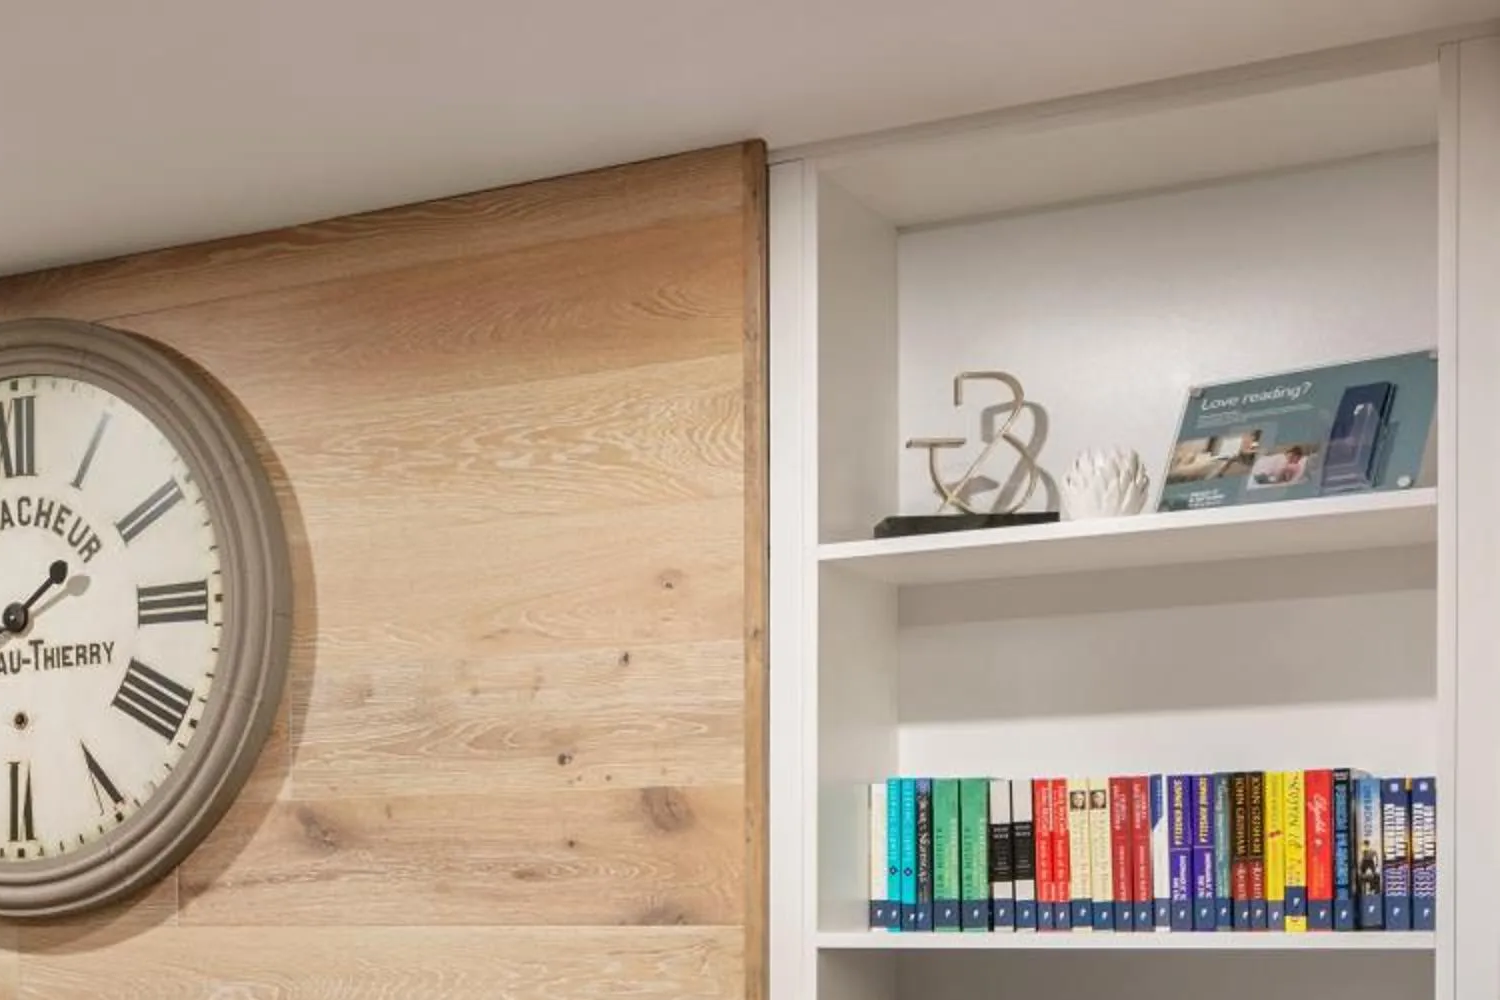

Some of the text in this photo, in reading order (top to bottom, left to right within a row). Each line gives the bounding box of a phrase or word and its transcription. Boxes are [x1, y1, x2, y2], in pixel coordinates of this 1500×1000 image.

[1200, 381, 1313, 412] Love reading?
[115, 477, 185, 544] II
[136, 578, 211, 628] III
